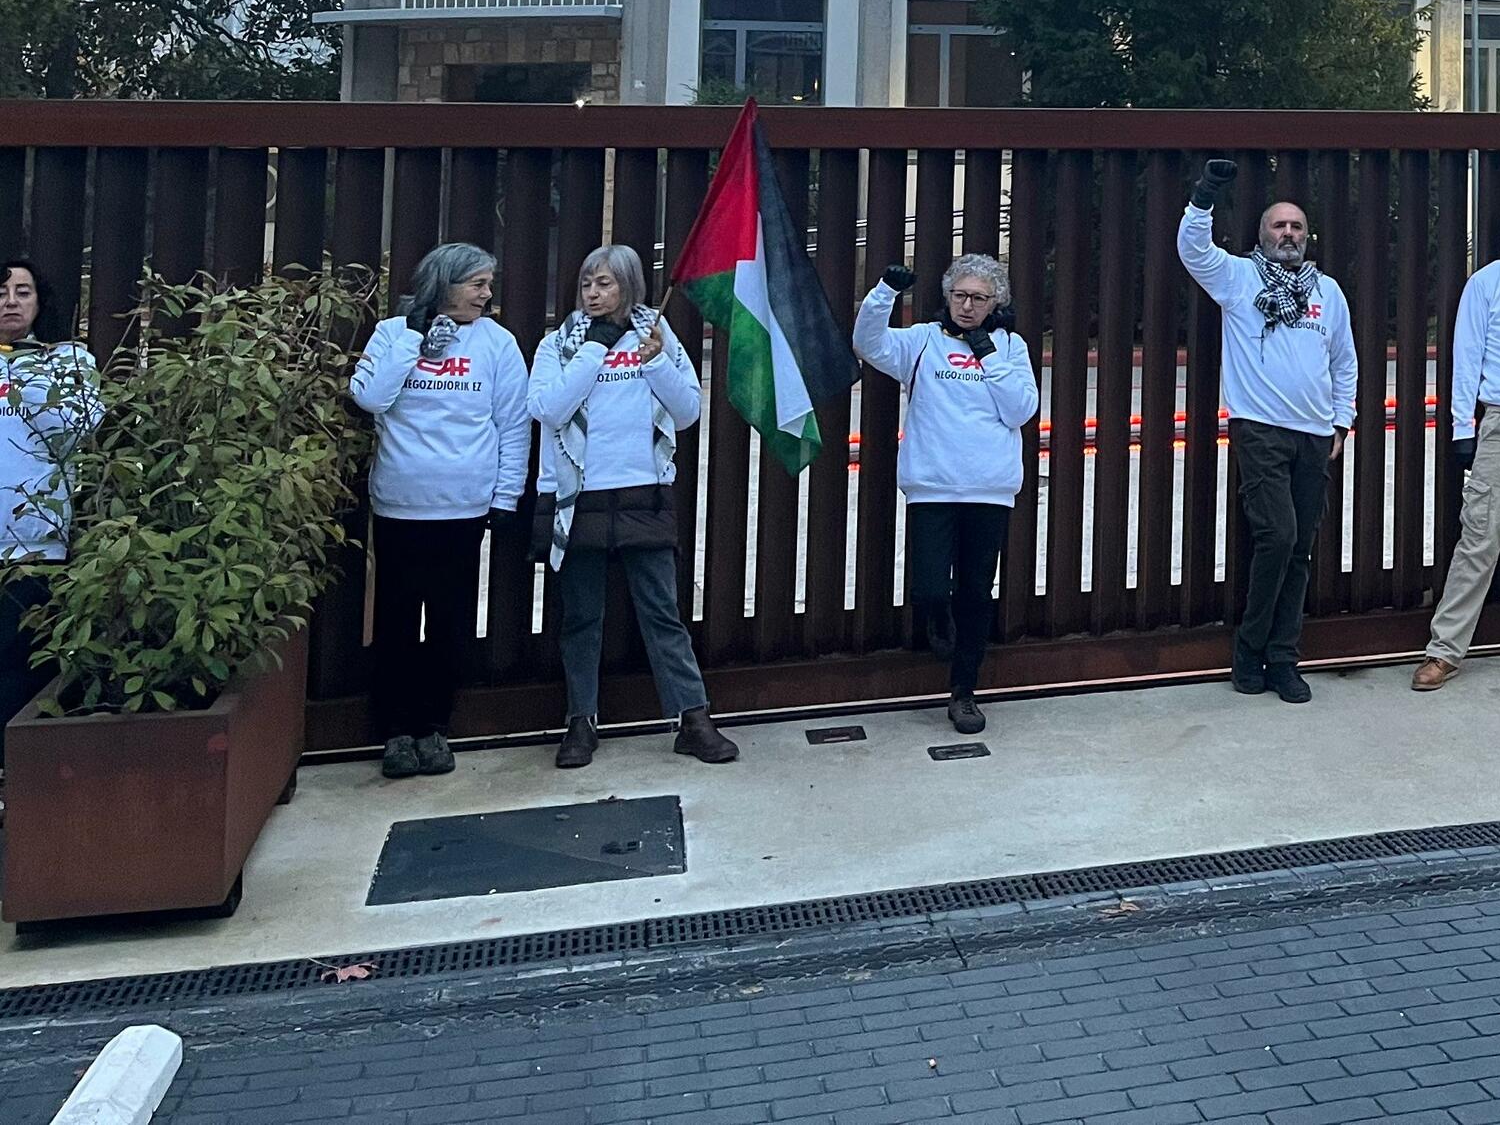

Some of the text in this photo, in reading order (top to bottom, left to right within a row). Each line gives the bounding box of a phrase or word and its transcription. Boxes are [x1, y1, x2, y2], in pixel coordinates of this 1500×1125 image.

[416, 357, 471, 376] CAF
[947, 353, 981, 369] CA
[934, 370, 985, 382] NEGOZIDIOR
[472, 382, 482, 392] EZ
